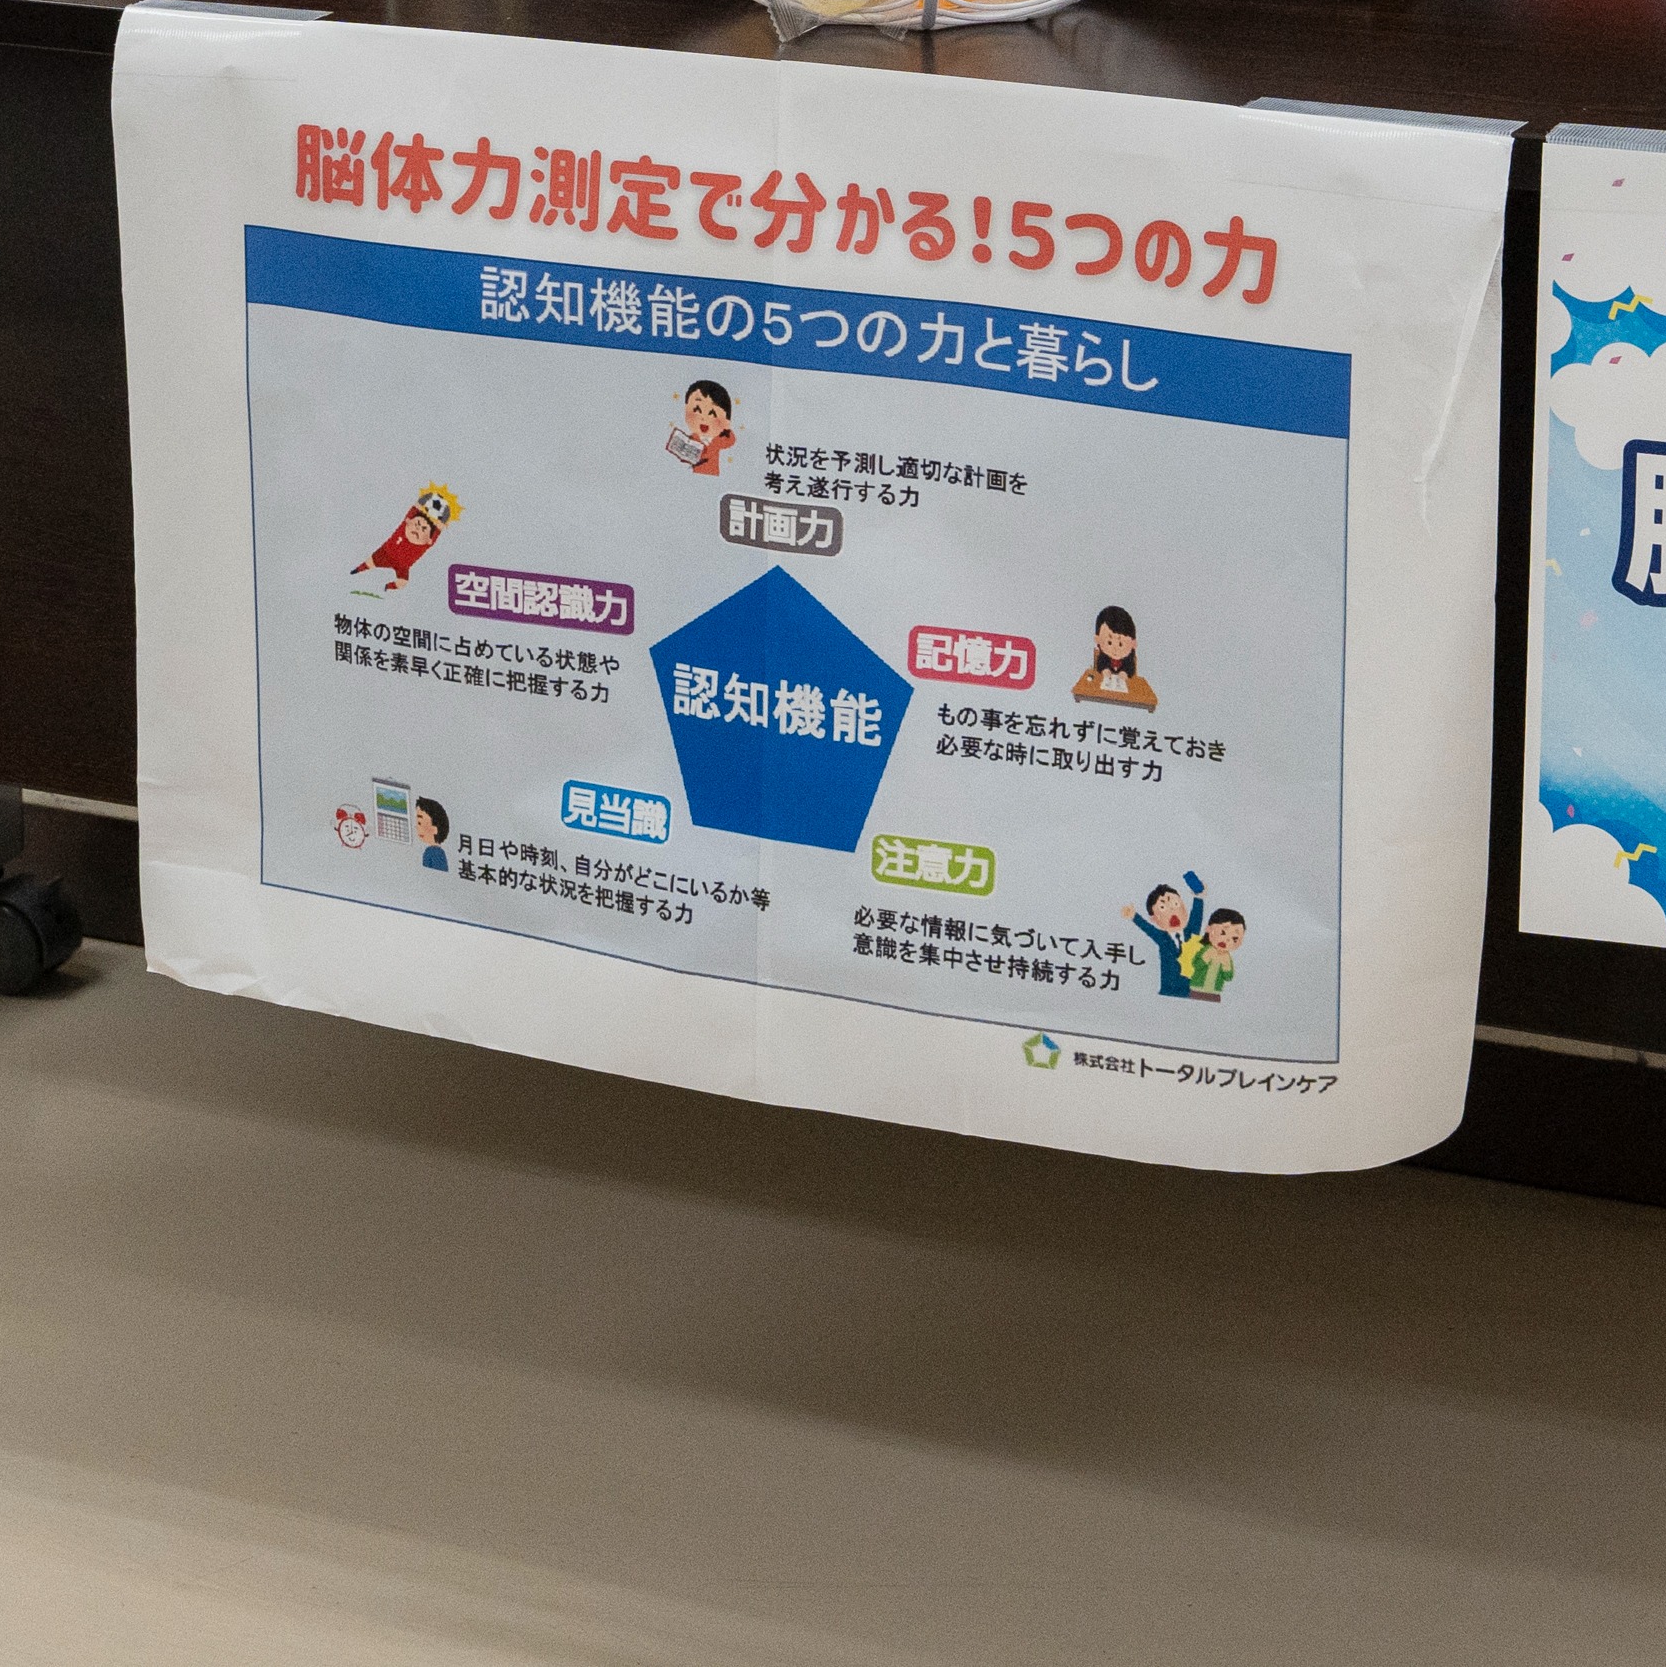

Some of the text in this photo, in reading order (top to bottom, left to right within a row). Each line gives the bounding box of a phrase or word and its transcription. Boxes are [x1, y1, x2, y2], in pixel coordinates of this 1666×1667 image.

[295, 121, 1277, 307] 脳体力測定で分かる！5つの力
[479, 268, 1161, 391] 認知機能の5つの力と暮らし
[764, 470, 920, 508] 考え遂行する力
[765, 443, 1027, 494] 状況を予測し適切な計画を
[729, 499, 835, 548] 計画力
[454, 570, 629, 626] 空間認識力
[334, 614, 620, 675] 物体の空間に占めている状態や
[334, 641, 609, 704] 関係を素早く正確に把握する力
[916, 633, 1029, 681] 記憶力
[673, 663, 882, 746] 認知機能
[937, 704, 1226, 762] もの事を忘れずに覚えておき
[936, 733, 1162, 782] 必要な時に取り出す力
[565, 786, 668, 839] 見当識
[457, 832, 770, 910] 月日や時刻、自分がどこにいるか等
[458, 860, 693, 925] 基本的な状況を把握する力
[875, 838, 990, 889] 注意力
[853, 932, 1120, 991] 意識を集中させ持続する力
[854, 905, 1146, 966] 必要な情報に気づいて入手し
